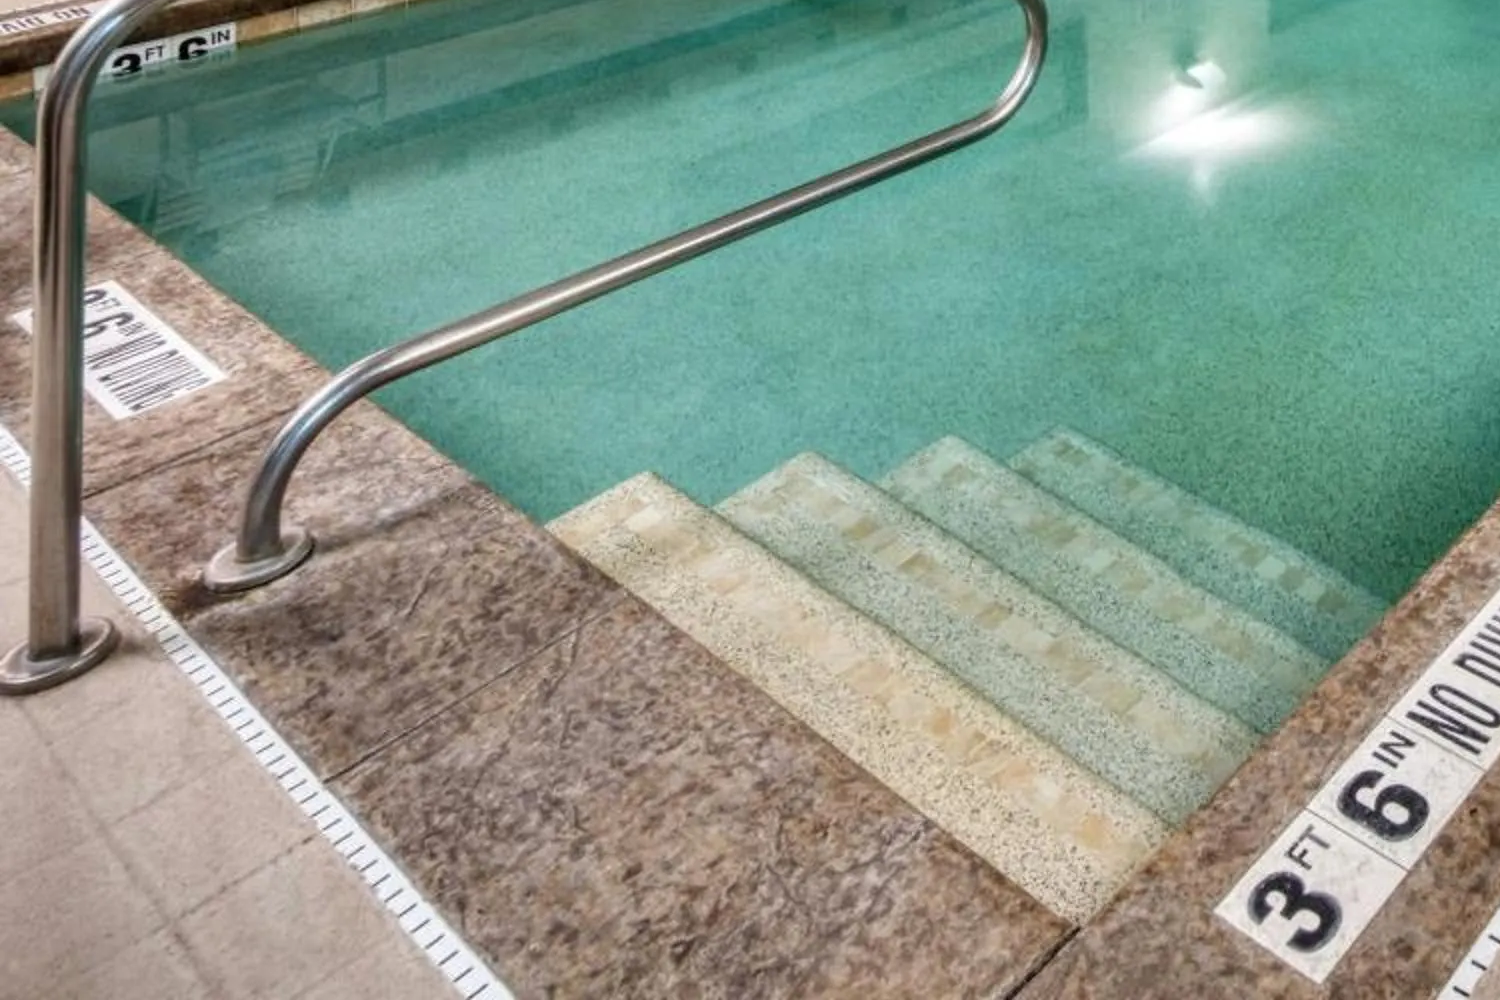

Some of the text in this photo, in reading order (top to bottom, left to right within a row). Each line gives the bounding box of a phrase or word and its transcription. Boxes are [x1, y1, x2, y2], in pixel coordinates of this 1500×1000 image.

[144, 44, 167, 62] FT
[210, 29, 231, 45] IN
[1371, 730, 1418, 770] IN
[1335, 769, 1431, 844] 6
[1283, 822, 1331, 872] FT
[1246, 870, 1343, 954] 3
